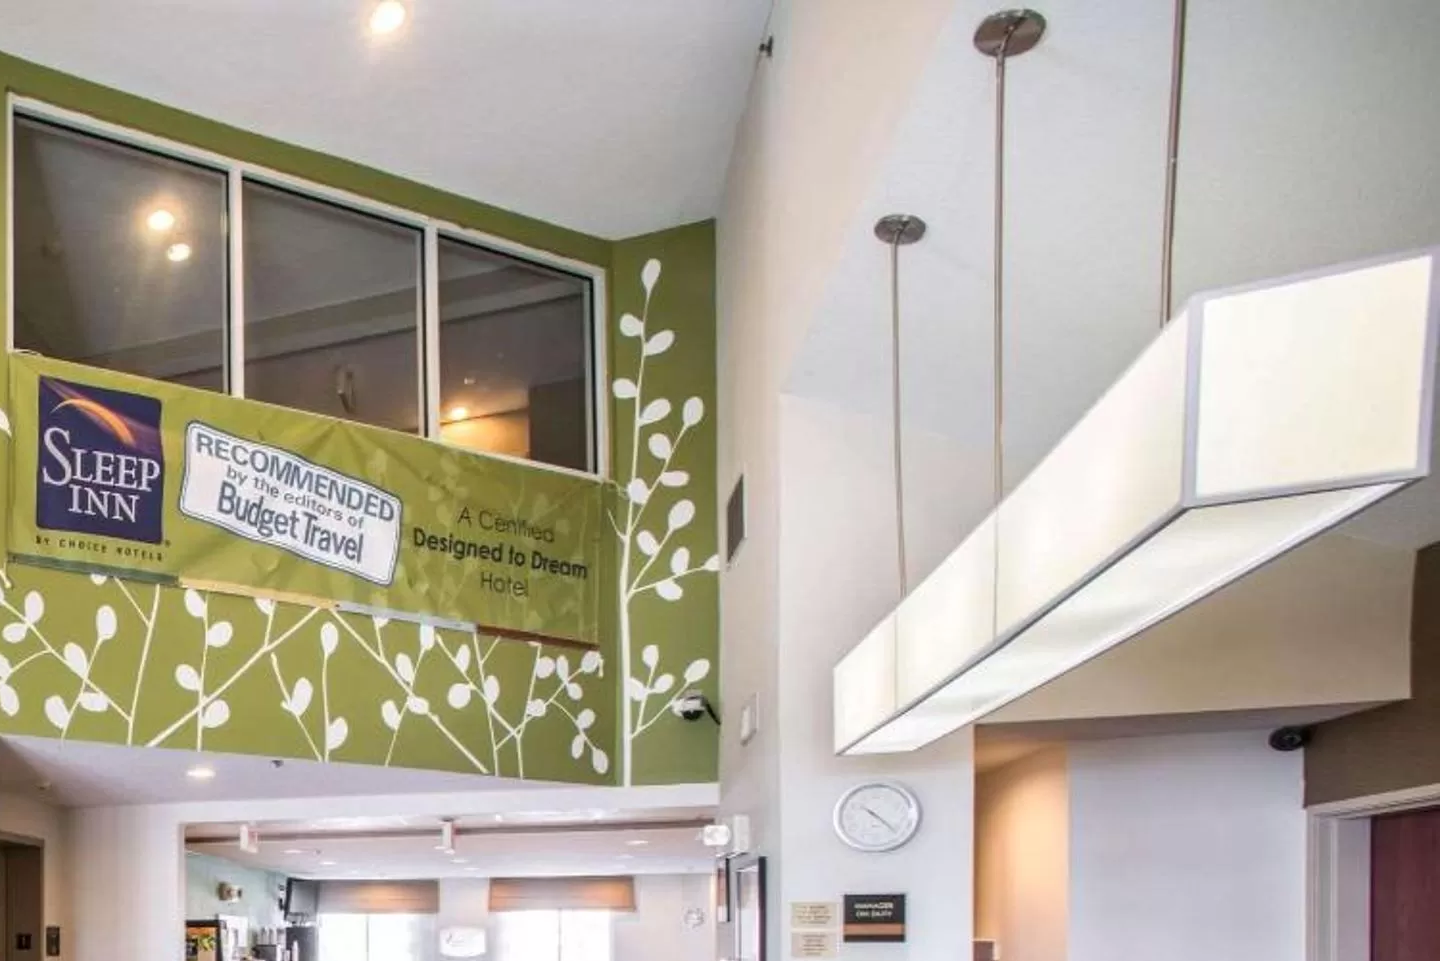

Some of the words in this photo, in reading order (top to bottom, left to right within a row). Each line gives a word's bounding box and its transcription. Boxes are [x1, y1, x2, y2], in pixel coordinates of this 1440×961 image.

[42, 427, 160, 492] SLEEP
[196, 432, 395, 522] RECOMMENDED
[68, 484, 140, 523] INN
[217, 481, 300, 538] Budget
[303, 511, 364, 564] Travel
[226, 464, 248, 485] by
[252, 474, 279, 498] the
[284, 492, 343, 521] editors
[348, 516, 364, 530] of
[59, 538, 108, 554] CHOICE
[117, 547, 163, 561] HOTELS
[457, 505, 472, 528] A
[479, 509, 556, 544] Certified
[413, 526, 504, 562] Designed
[508, 546, 526, 567] to
[531, 550, 588, 579] Dream
[480, 571, 529, 597] Hotel
